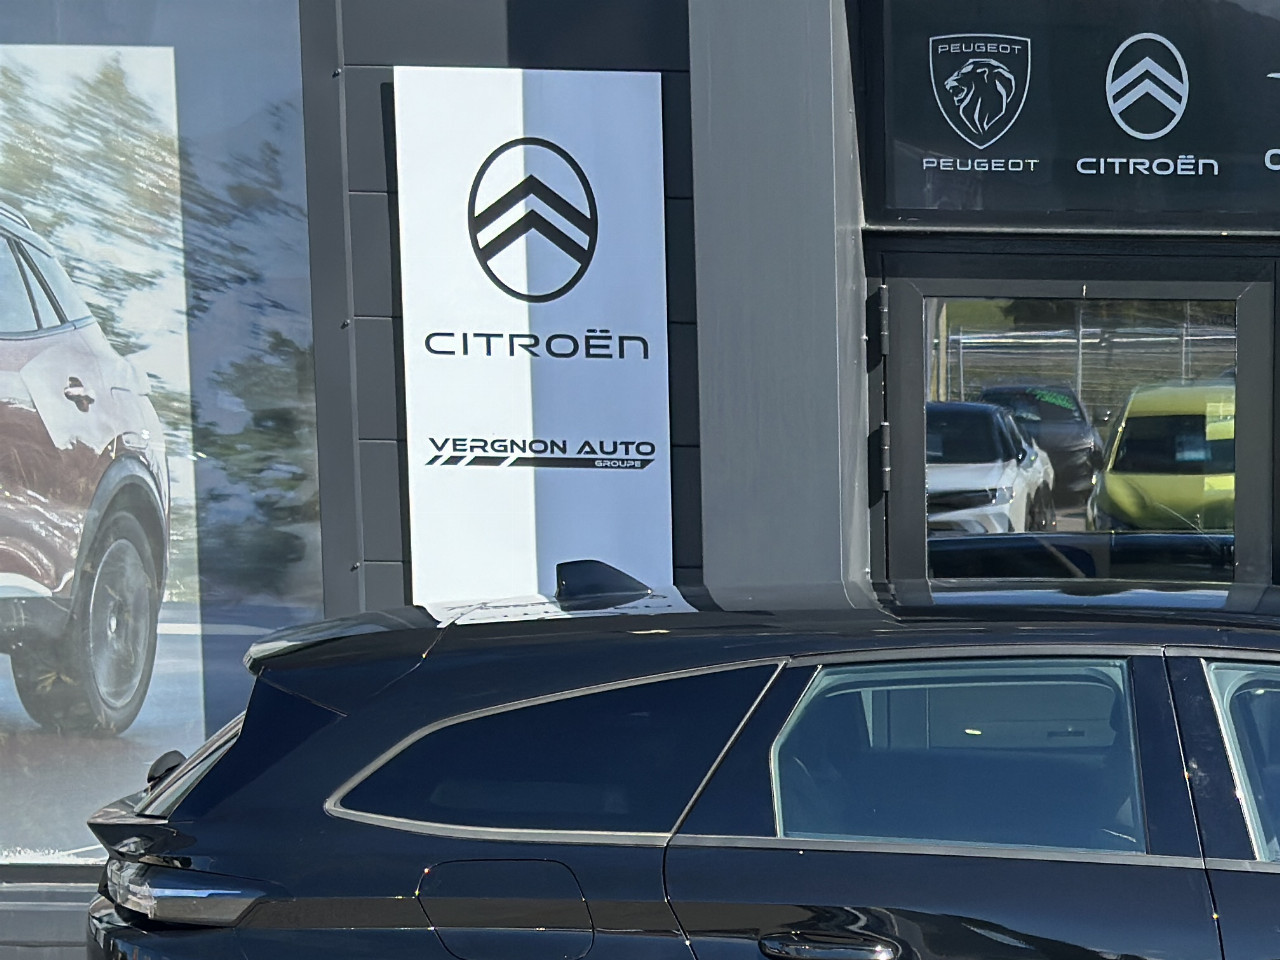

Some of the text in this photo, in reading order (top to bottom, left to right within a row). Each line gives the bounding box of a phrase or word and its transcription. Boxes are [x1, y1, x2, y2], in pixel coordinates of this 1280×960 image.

[938, 44, 1021, 54] PEUGEOT
[923, 158, 1040, 171] PEUGEOT
[428, 438, 655, 456] VERGNON AUTO
[595, 459, 641, 468] GROUPE
